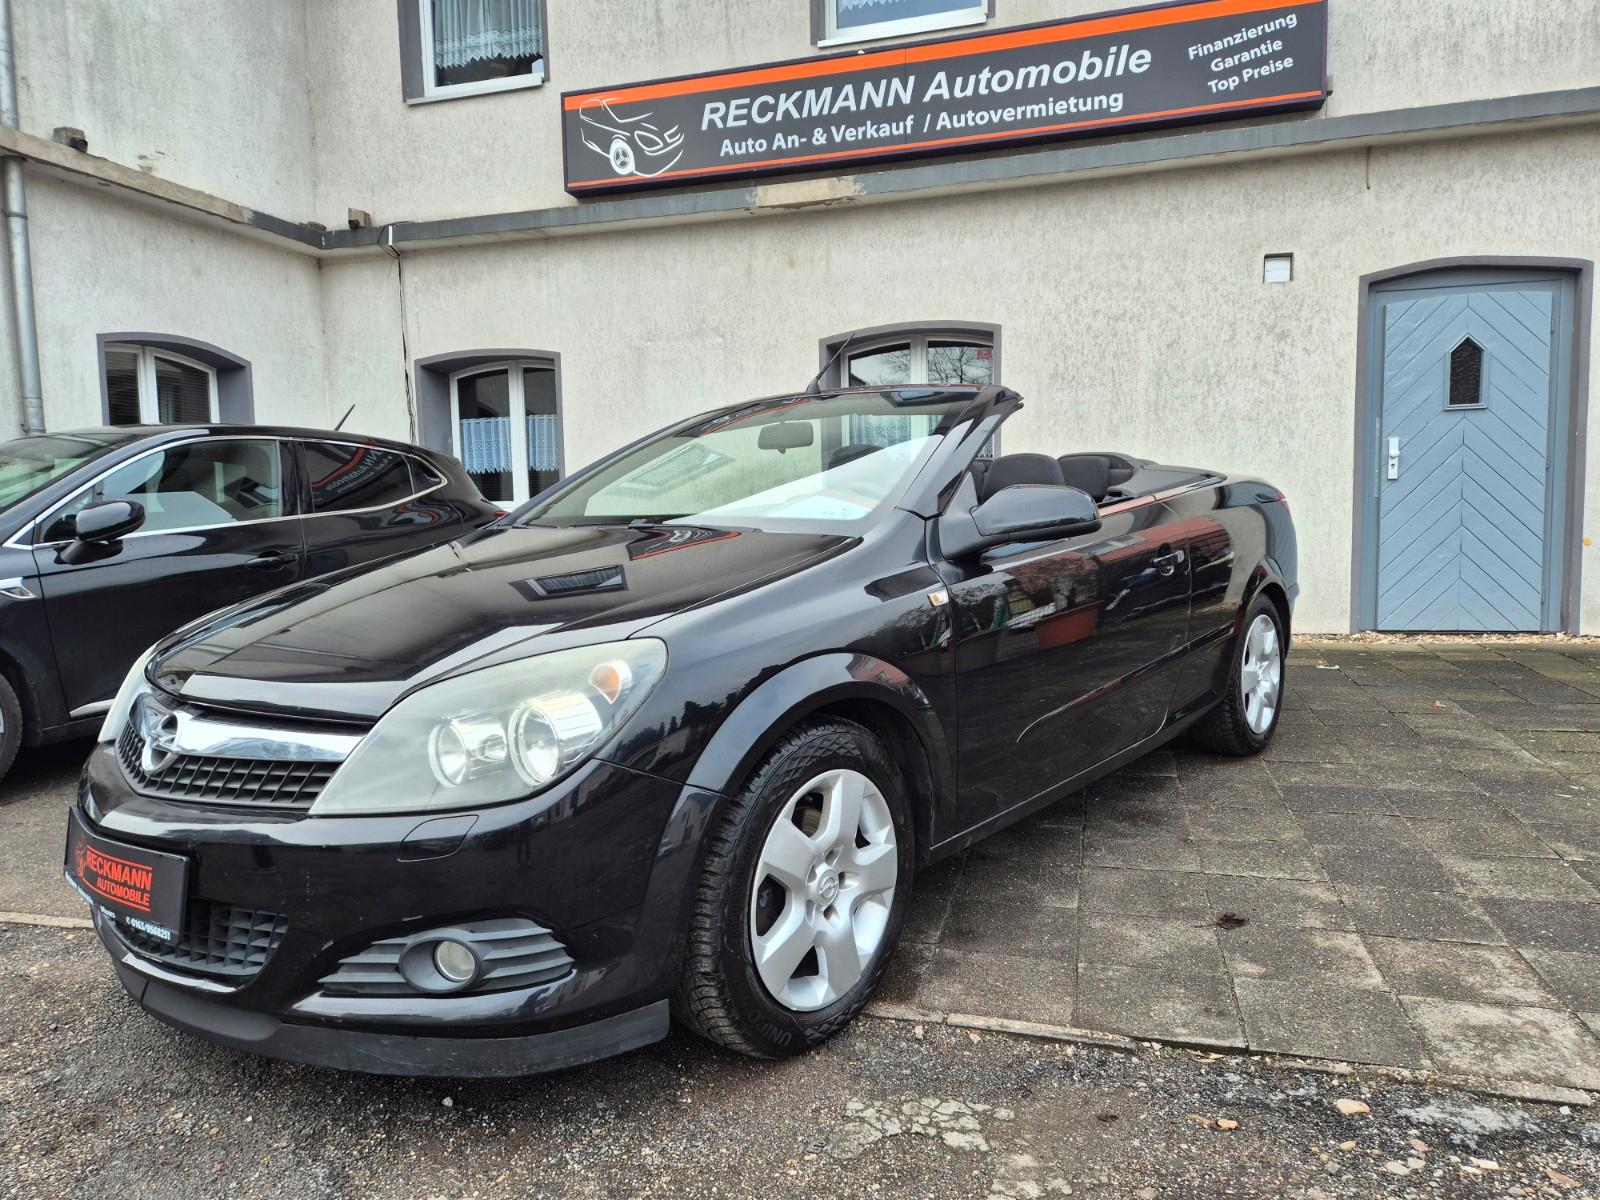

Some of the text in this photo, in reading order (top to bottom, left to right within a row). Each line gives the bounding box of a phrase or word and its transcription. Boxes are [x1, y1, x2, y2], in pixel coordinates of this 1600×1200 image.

[1187, 13, 1298, 61] Finanzierung
[1210, 38, 1283, 73] Garantie
[700, 43, 1152, 132] RECKMANN Automobile
[1207, 57, 1294, 94] Top Preise
[719, 92, 1124, 158] Auto An- & Verkauf / Autovermietung
[86, 849, 153, 891] RECKMANN
[96, 877, 151, 906] AUTOMOBILE
